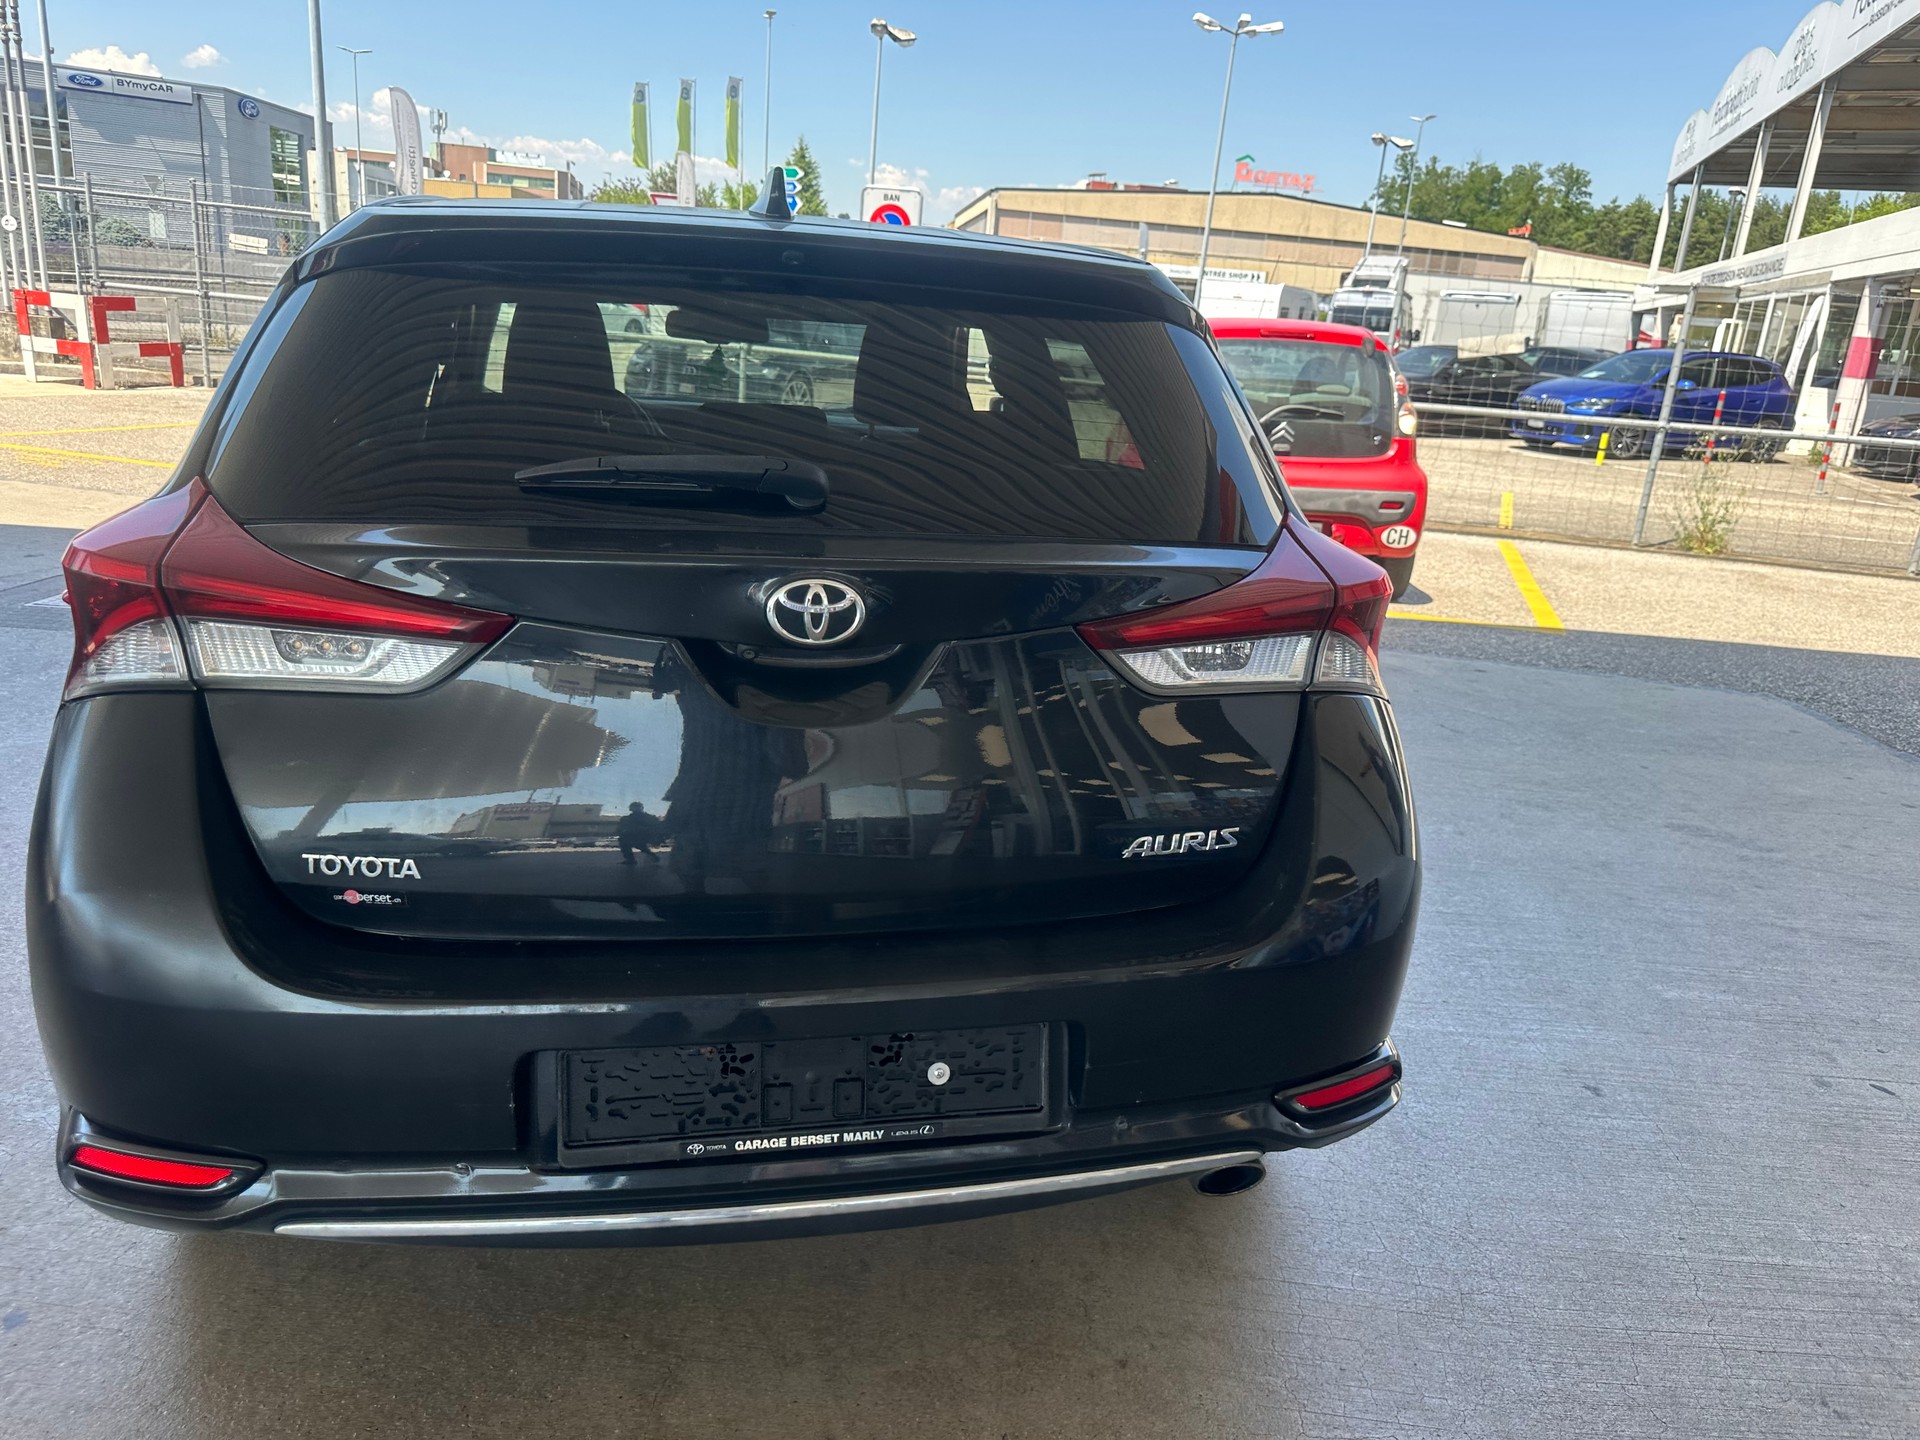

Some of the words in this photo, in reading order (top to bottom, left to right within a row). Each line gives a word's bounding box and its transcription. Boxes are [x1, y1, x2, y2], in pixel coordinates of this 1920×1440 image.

[116, 78, 174, 94] BYmyCAR
[883, 193, 901, 203] BAN
[1386, 528, 1410, 545] CH
[1121, 826, 1240, 859] AURIS
[301, 853, 421, 880] TOYOTA
[734, 1137, 787, 1151] GARAGE
[791, 1133, 840, 1147] BERSET
[843, 1129, 885, 1143] MARLY
